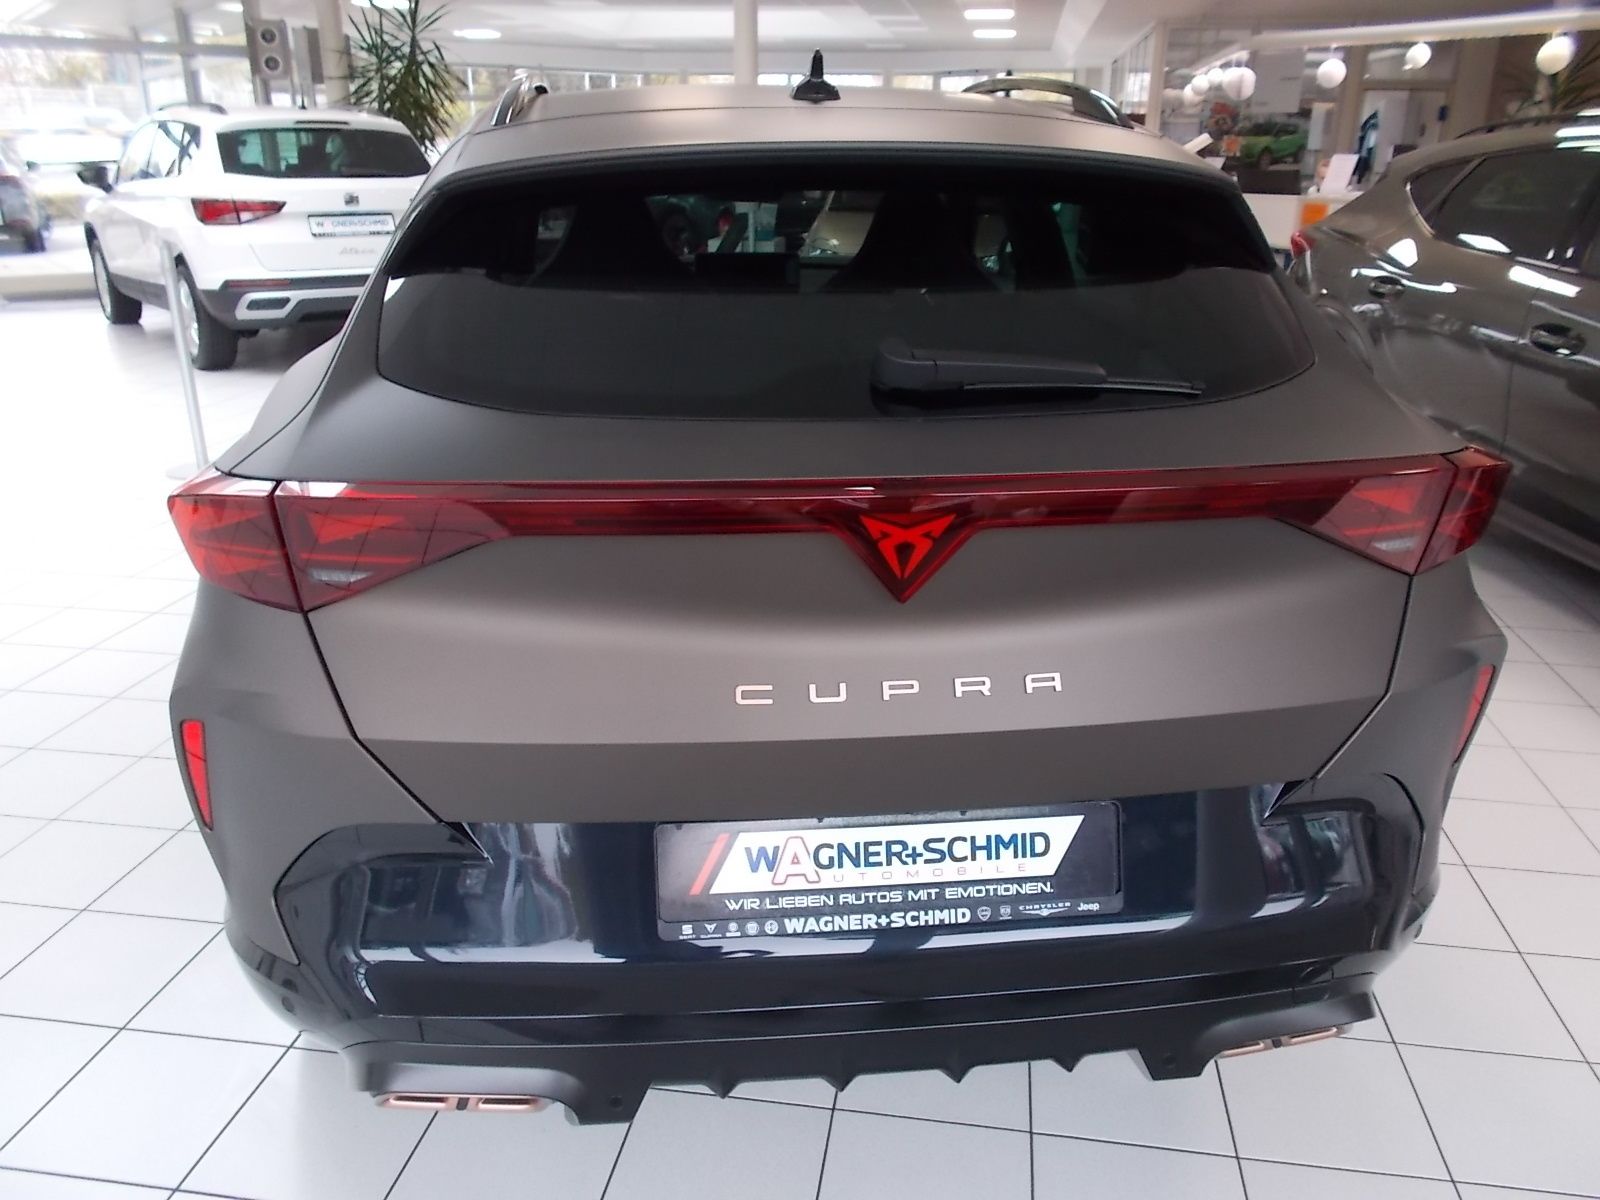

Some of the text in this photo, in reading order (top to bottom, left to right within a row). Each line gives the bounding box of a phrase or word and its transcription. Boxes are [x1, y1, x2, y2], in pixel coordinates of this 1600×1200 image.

[735, 672, 1062, 705] CUPRA
[744, 831, 1051, 886] WAGNER+SCHMID
[724, 881, 1054, 912] WIR LIEBEN AUTOS MIT EMOTIONEN.
[784, 907, 971, 935] WAGNER+SCHMID
[1019, 902, 1071, 911] CHRYSLER
[1077, 902, 1100, 912] Jeep
